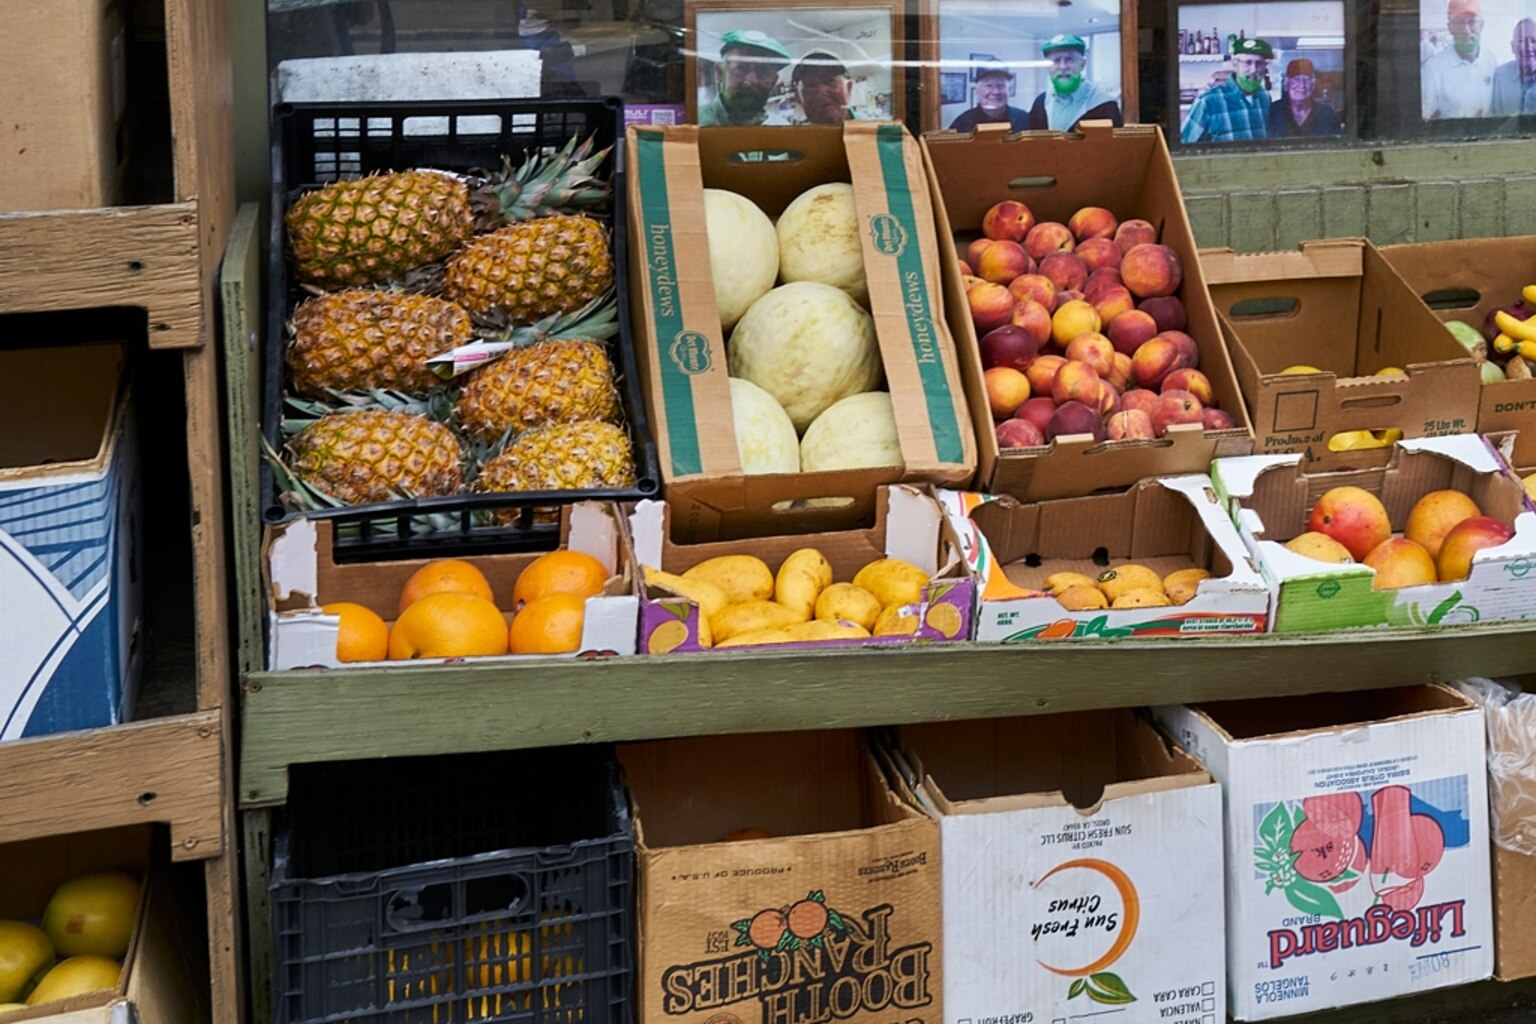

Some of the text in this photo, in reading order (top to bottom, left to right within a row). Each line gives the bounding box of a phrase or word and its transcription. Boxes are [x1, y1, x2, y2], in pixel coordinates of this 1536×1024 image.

[648, 223, 678, 317] honeydews
[905, 271, 935, 365] honeydews
[1495, 400, 1536, 413] DON'T
[1423, 419, 1435, 432] 25
[1264, 432, 1325, 447] Produce of
[1314, 777, 1360, 788] ASSOCIATION
[1361, 773, 1385, 783] CITRUS
[1040, 824, 1132, 846] SUN FRESH CITRUS LLC
[678, 866, 785, 881] PRODUCE OF U.S.A.
[1047, 893, 1102, 916] Citrus
[1031, 912, 1118, 943] Sun Fresh
[1281, 913, 1321, 928] BRAND
[1267, 899, 1466, 971] Lifeguard
[704, 939, 730, 954] EST
[661, 904, 894, 1015] RANCHES
[761, 942, 932, 1024] BOOTH
[1254, 975, 1310, 994] TANGELOS
[1153, 984, 1201, 1003] CARA CARA
[1255, 985, 1309, 1005] MINNEOLA
[1159, 1001, 1201, 1017] VALENCIA
